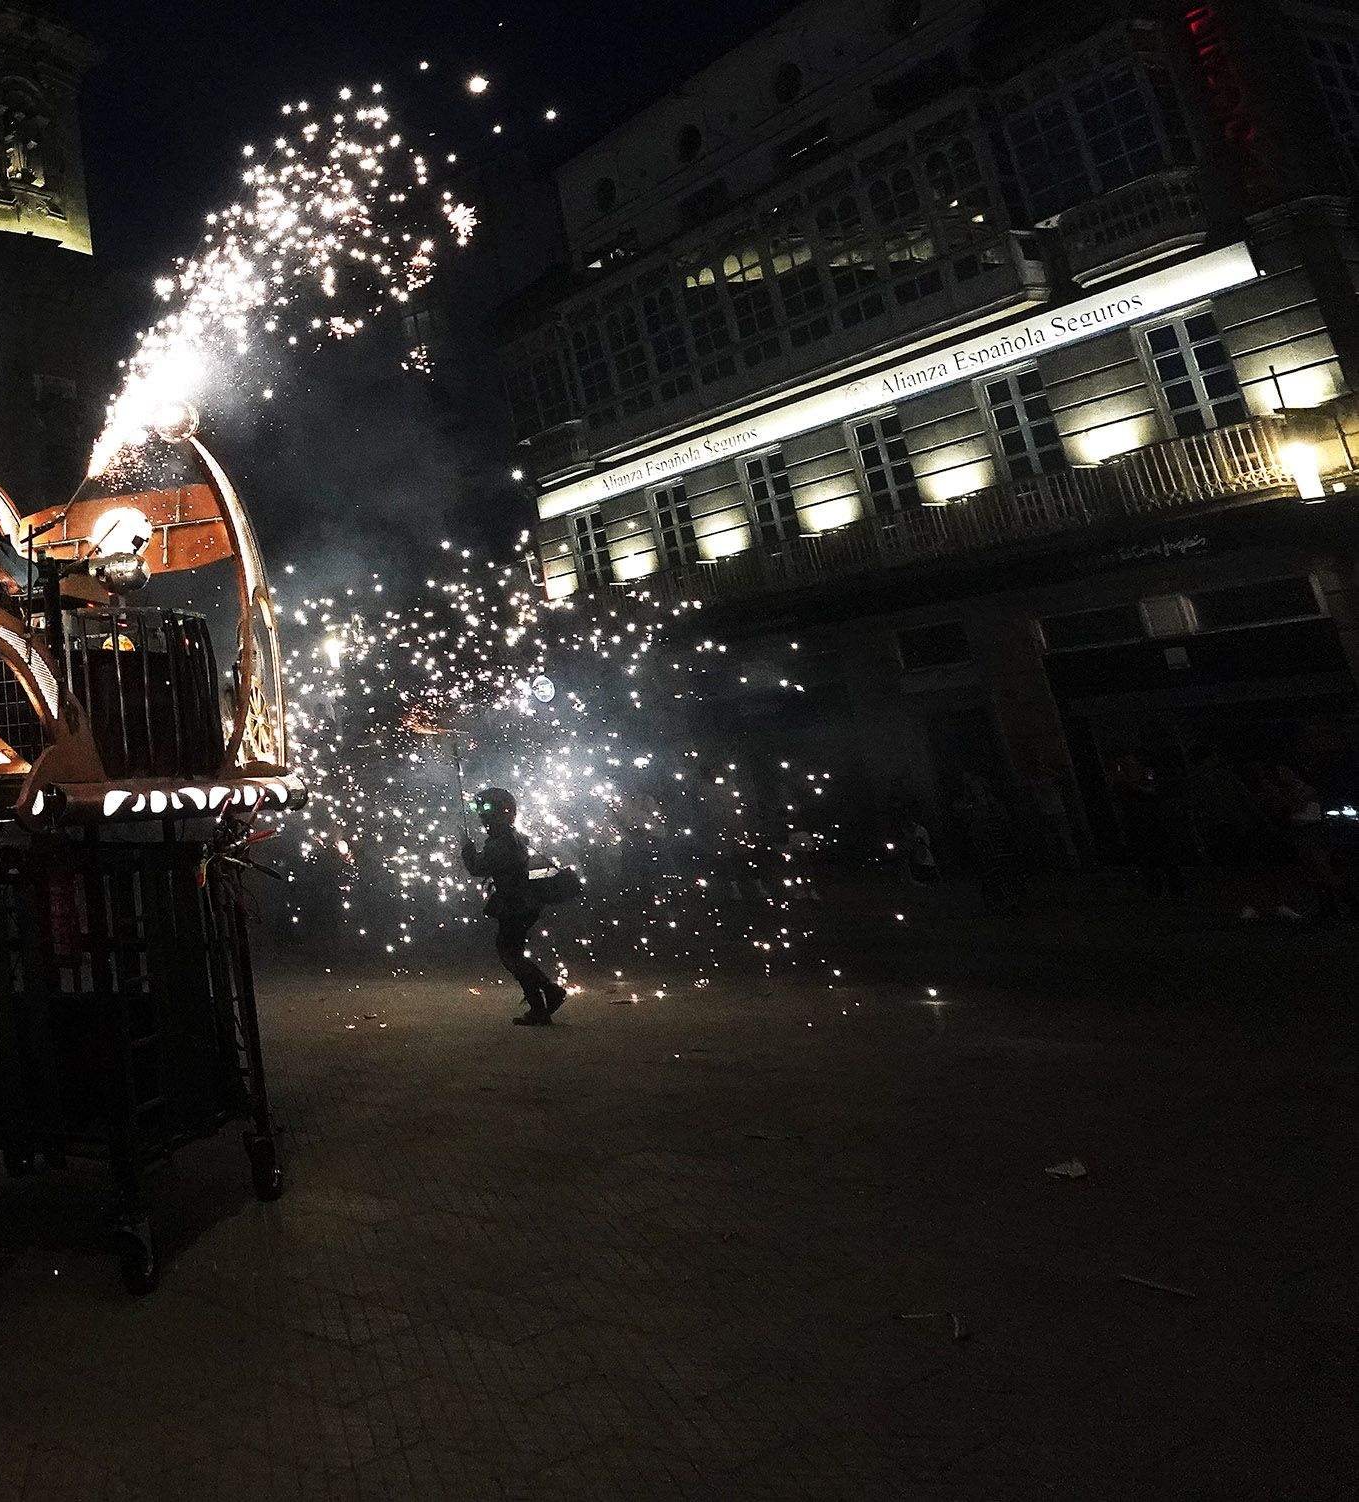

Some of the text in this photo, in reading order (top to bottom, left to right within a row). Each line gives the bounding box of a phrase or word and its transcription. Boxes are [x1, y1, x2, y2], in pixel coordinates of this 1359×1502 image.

[881, 294, 1144, 394] Alianza Española Seguros
[601, 428, 759, 491] Alianza Española Seguros
